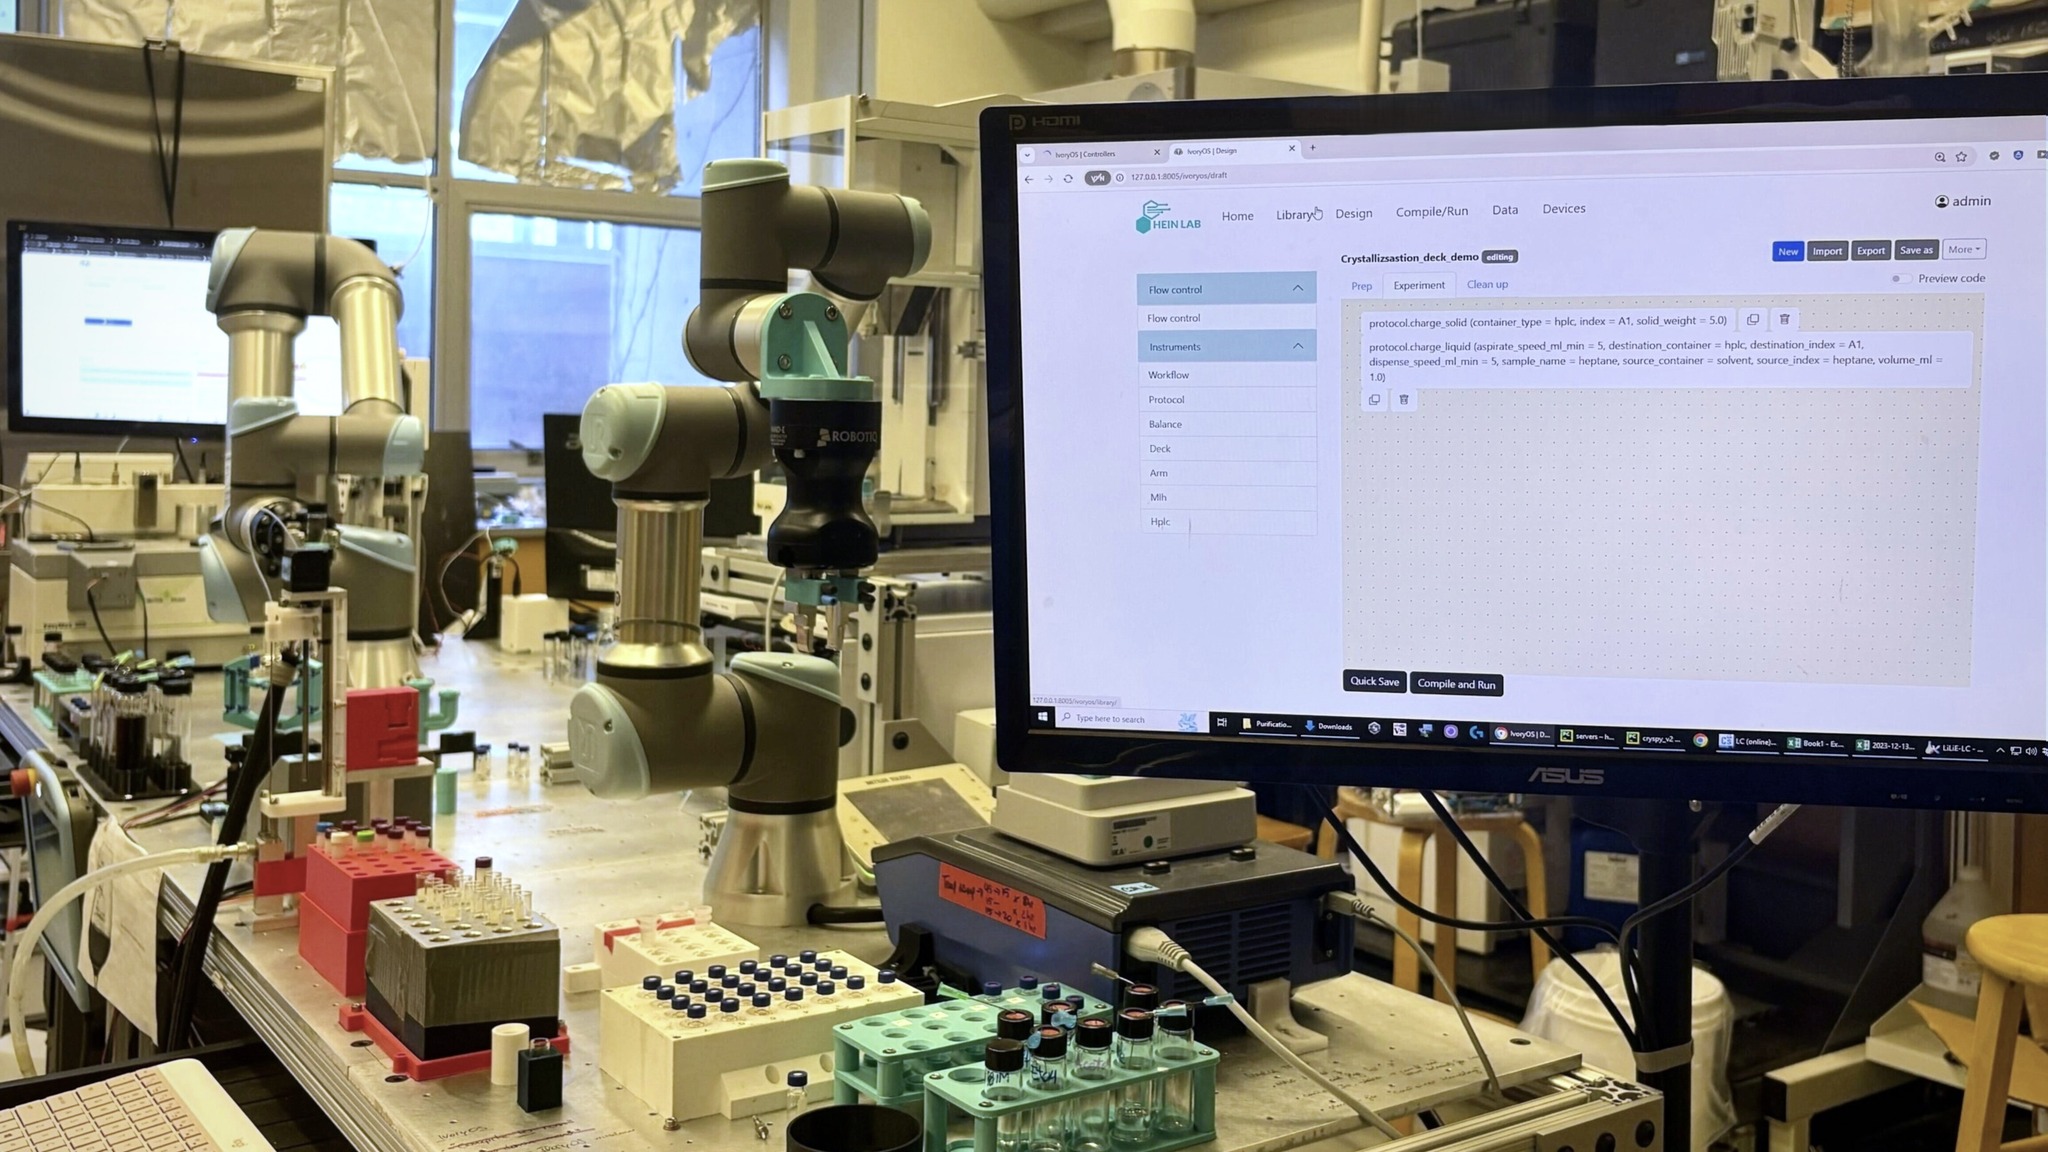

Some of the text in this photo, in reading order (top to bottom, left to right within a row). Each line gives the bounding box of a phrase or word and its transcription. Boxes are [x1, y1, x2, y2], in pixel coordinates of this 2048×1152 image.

[1032, 115, 1081, 127] HDMI
[1055, 151, 1079, 159] IvoryOS
[1083, 150, 1116, 158] Controllers
[1187, 147, 1211, 156] IvoryOS
[1215, 147, 1238, 155] Design
[1131, 172, 1228, 182] 127.0.0.1:8005/ivoryos/draft
[1952, 196, 1992, 207] admin
[1396, 206, 1469, 219] Compile/Run
[1492, 205, 1519, 216] Data
[1542, 203, 1586, 215] Devices
[1222, 212, 1254, 222] Home
[1276, 209, 1314, 223] Library
[1335, 208, 1373, 221] Design
[1153, 219, 1201, 230] HEIN LAB
[1778, 247, 1799, 256] New
[1813, 247, 1843, 257] Import
[1857, 246, 1886, 256] Export
[1900, 246, 1934, 255] Save as
[1948, 245, 1973, 254] More
[1341, 252, 1480, 264] Crystallizsastion_deck_demo
[1486, 253, 1514, 262] editing
[1918, 273, 1986, 283] Preview code
[1149, 285, 1203, 294] Flow control
[1351, 282, 1373, 293] Prep
[1394, 280, 1446, 292] Experiment
[1467, 279, 1509, 291] Clean up
[1147, 313, 1201, 323] Flow control
[1369, 318, 1467, 329] protocol.charge_solid
[1470, 317, 1542, 328] (container_type
[1554, 316, 1577, 327] hplc,
[1579, 316, 1606, 326] index
[1618, 316, 1634, 326] A1,
[1636, 316, 1696, 327] solid_weight
[1709, 315, 1727, 327] 5.0)
[1150, 343, 1201, 352] Instruments
[1369, 342, 1471, 353] protocol.charge_liquid
[1474, 341, 1585, 352] (aspirate_speed_ml_min
[1597, 341, 1606, 351] 5,
[1608, 340, 1712, 351] destination_container
[1724, 340, 1748, 351] hplc,
[1750, 340, 1836, 351] destination_index
[1848, 340, 1864, 350] A1,
[1369, 356, 1479, 368] dispense_speed_ml_min
[1491, 357, 1499, 367] 5,
[1502, 356, 1566, 367] sample_name
[1578, 356, 1620, 367] heptane,
[1622, 356, 1704, 366] source_container
[1716, 356, 1754, 366] solvent,
[1756, 355, 1820, 366] source_index
[1832, 355, 1876, 366] heptane,
[1878, 355, 1933, 365] volume_ml
[1148, 370, 1190, 380] Workflow
[1370, 372, 1386, 383] 1.0)
[1148, 395, 1185, 404] Protocol
[1149, 420, 1183, 429] Balance
[832, 430, 878, 443] ROBOTIQ
[1149, 444, 1171, 453] Deck
[1150, 469, 1168, 477] Arm
[1150, 493, 1167, 502] Mlh
[1150, 518, 1171, 528] Hplc
[1350, 676, 1400, 687] Quick Save
[1417, 678, 1496, 690] Compile and Run
[1076, 714, 1145, 724] Type here to search
[1318, 722, 1353, 731] Downloads
[1510, 730, 1535, 740] IvoryOS
[1642, 735, 1674, 744] cryspy_v2
[1735, 737, 1744, 745] LC
[1803, 739, 1824, 747] Book1
[1528, 767, 1605, 785] ASUS
